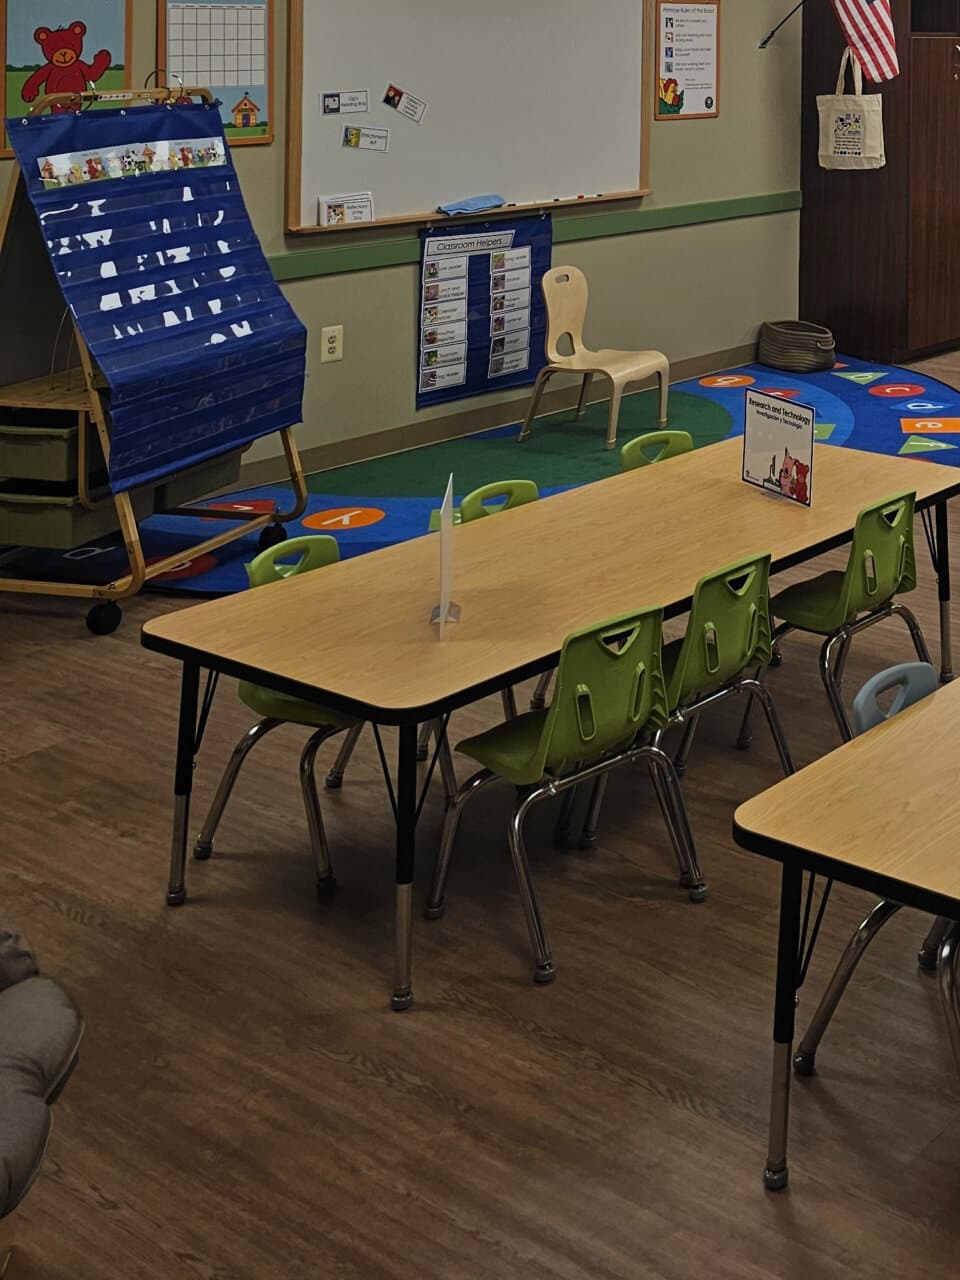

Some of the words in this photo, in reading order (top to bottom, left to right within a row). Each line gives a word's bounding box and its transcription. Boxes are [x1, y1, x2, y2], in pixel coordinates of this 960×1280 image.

[437, 241, 475, 251] Classroom
[748, 396, 771, 411] Research
[771, 406, 782, 415] and
[782, 407, 811, 426] Technology
